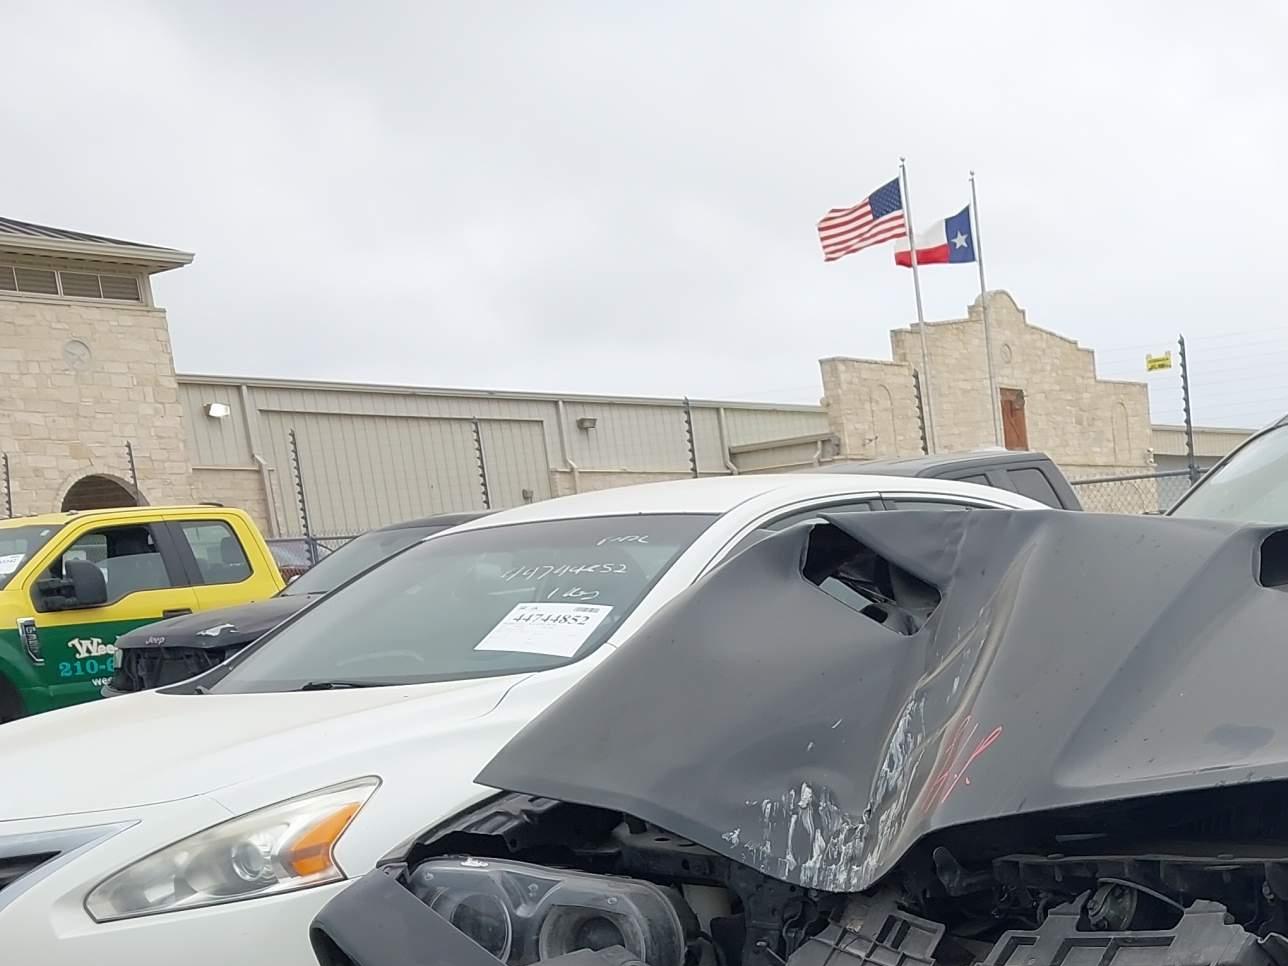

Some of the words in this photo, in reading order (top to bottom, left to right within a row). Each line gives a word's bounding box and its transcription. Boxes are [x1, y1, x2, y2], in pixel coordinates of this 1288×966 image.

[513, 613, 591, 626] 44744852
[67, 635, 120, 659] Wee
[145, 636, 165, 645] Jeep
